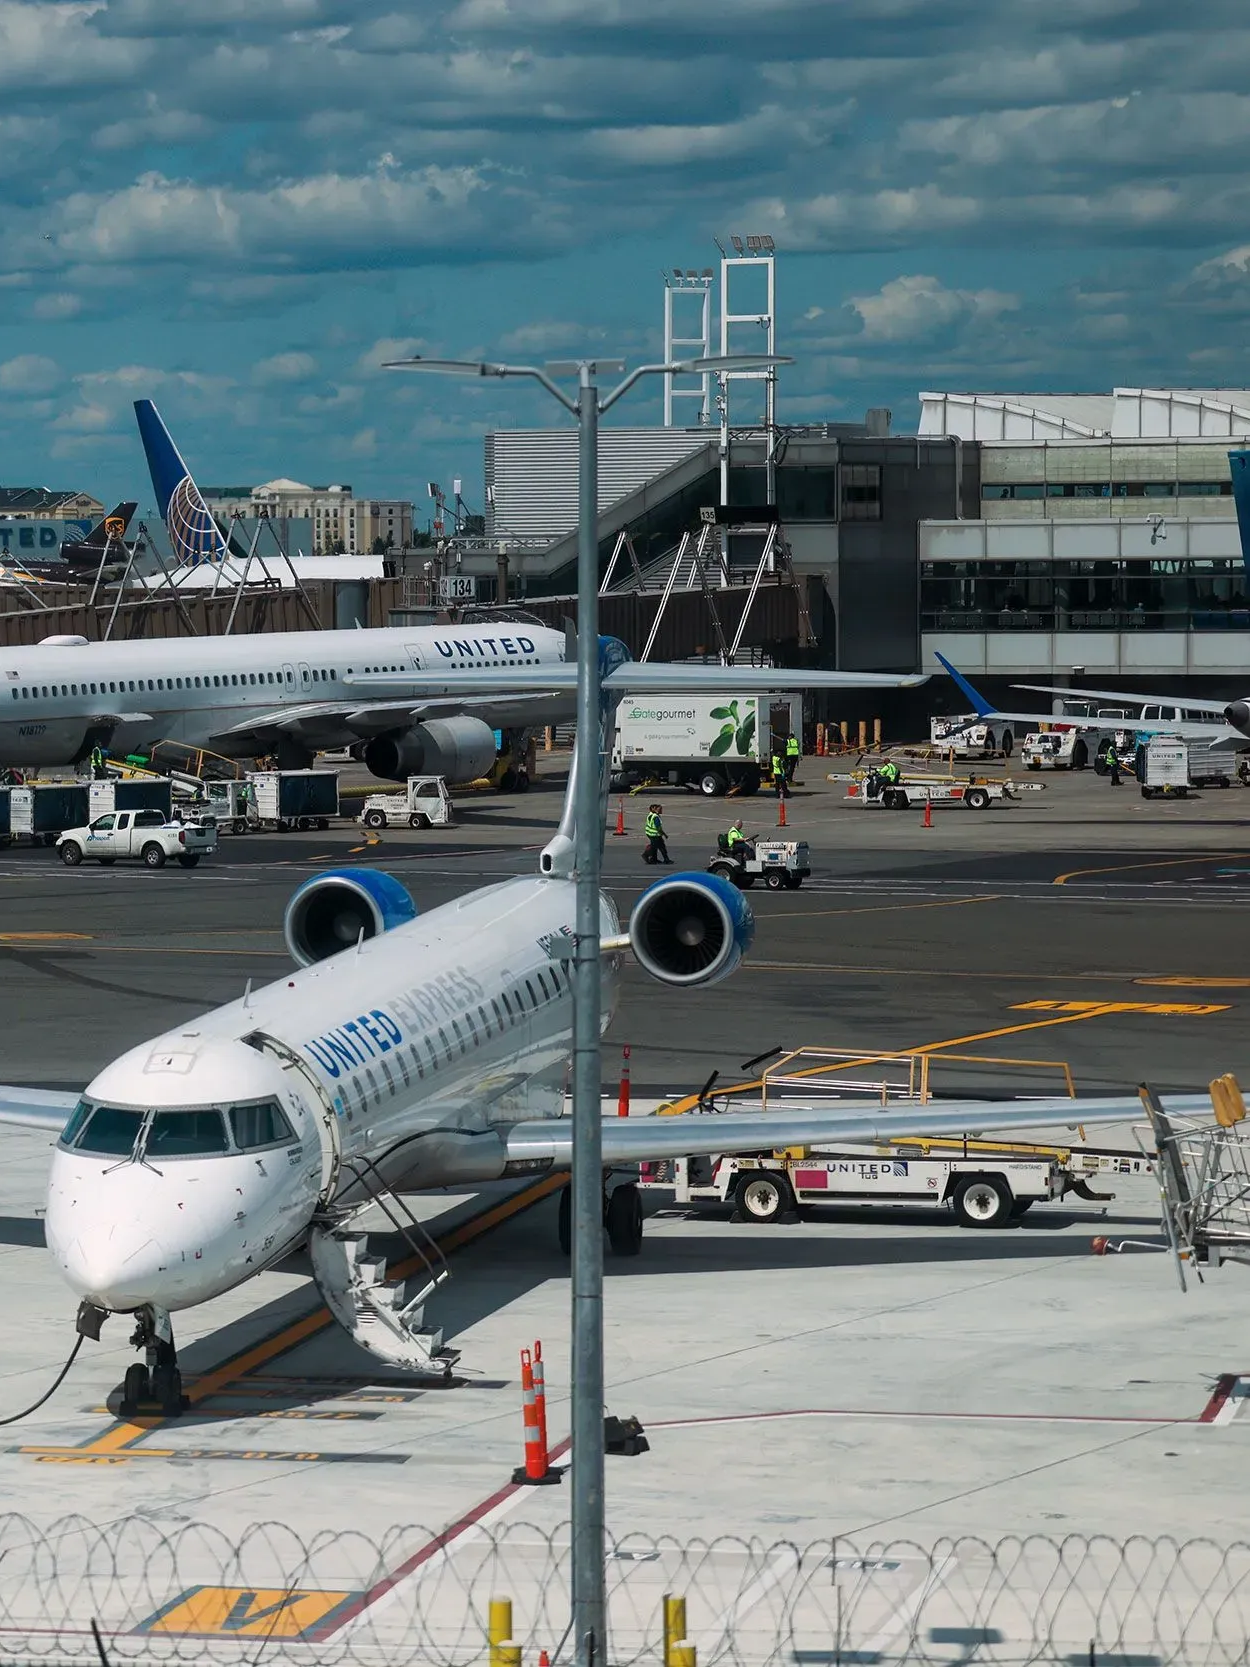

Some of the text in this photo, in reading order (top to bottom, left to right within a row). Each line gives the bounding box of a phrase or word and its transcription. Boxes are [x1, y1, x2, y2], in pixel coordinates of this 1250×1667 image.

[702, 511, 715, 519] 135
[452, 579, 472, 595] 134
[433, 637, 536, 658] UNITED
[303, 965, 485, 1079] UNITED EXPRESS
[827, 1163, 891, 1173] UNITED
